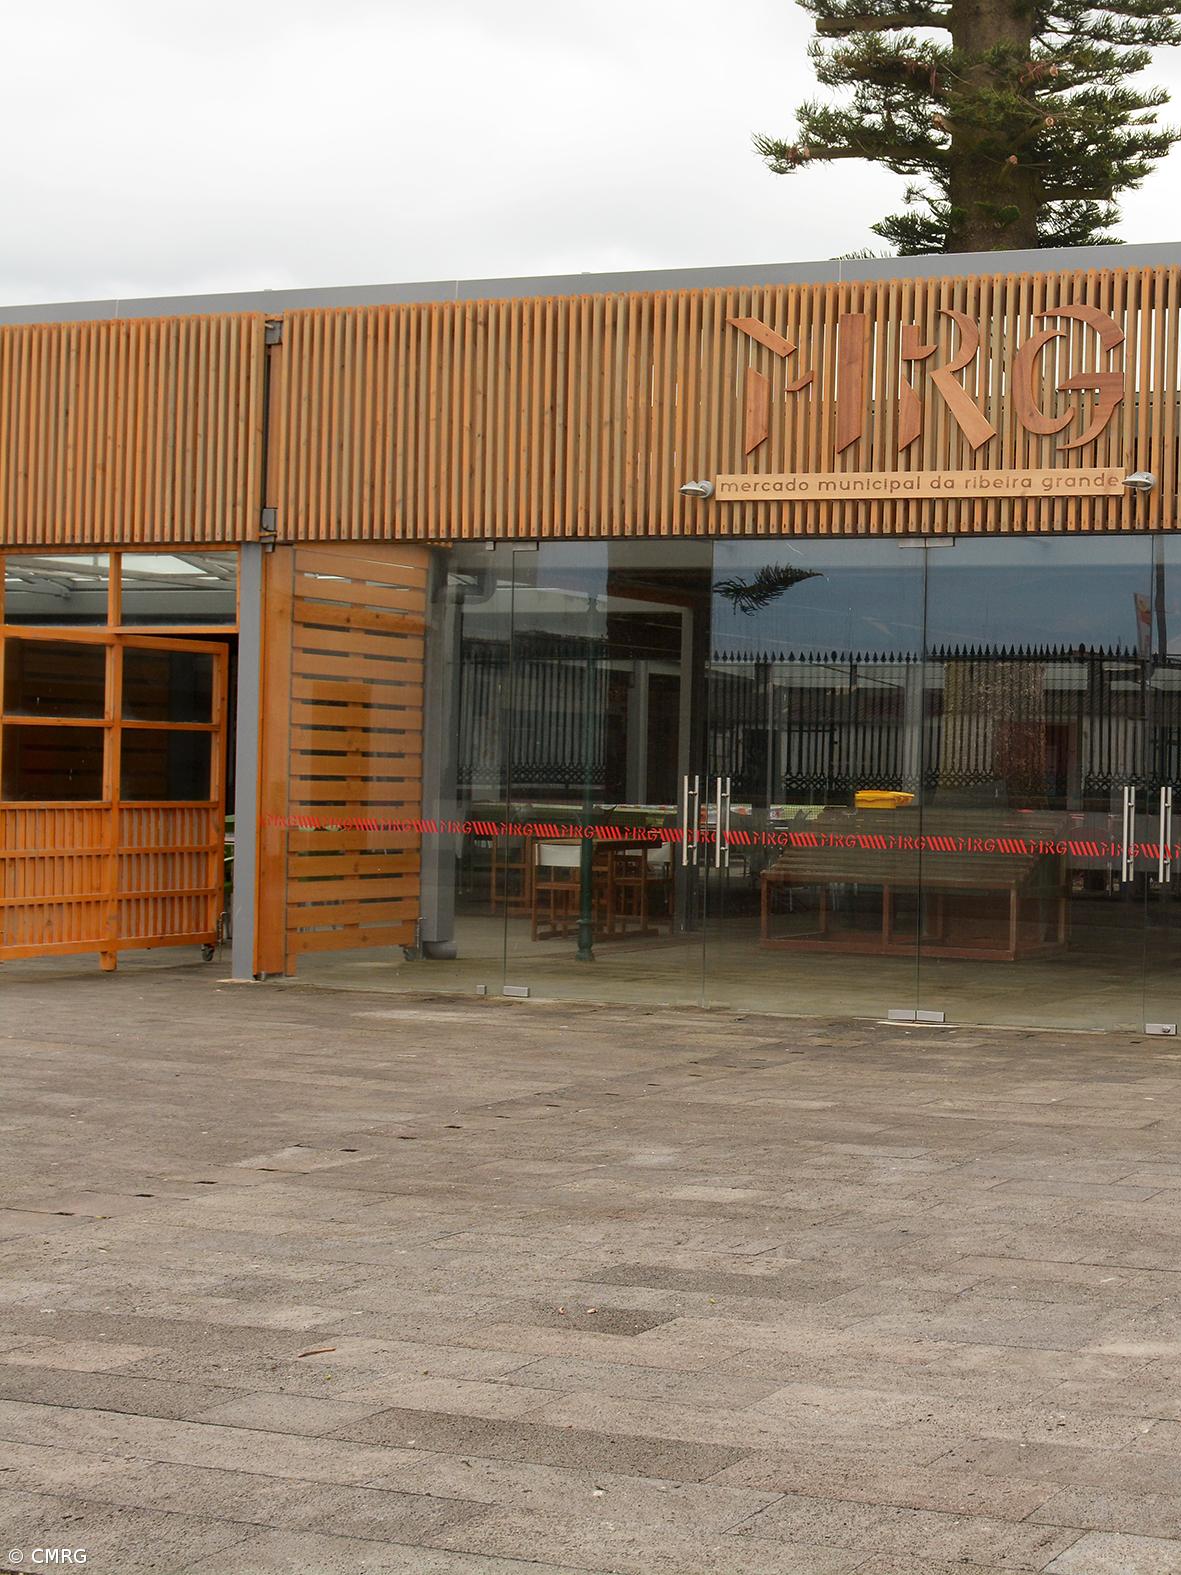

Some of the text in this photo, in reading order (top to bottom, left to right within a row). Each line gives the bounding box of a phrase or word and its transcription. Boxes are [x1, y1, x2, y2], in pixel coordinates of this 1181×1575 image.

[726, 304, 1125, 456] MRG
[720, 472, 1120, 493] mercado municipal da ribeira grande
